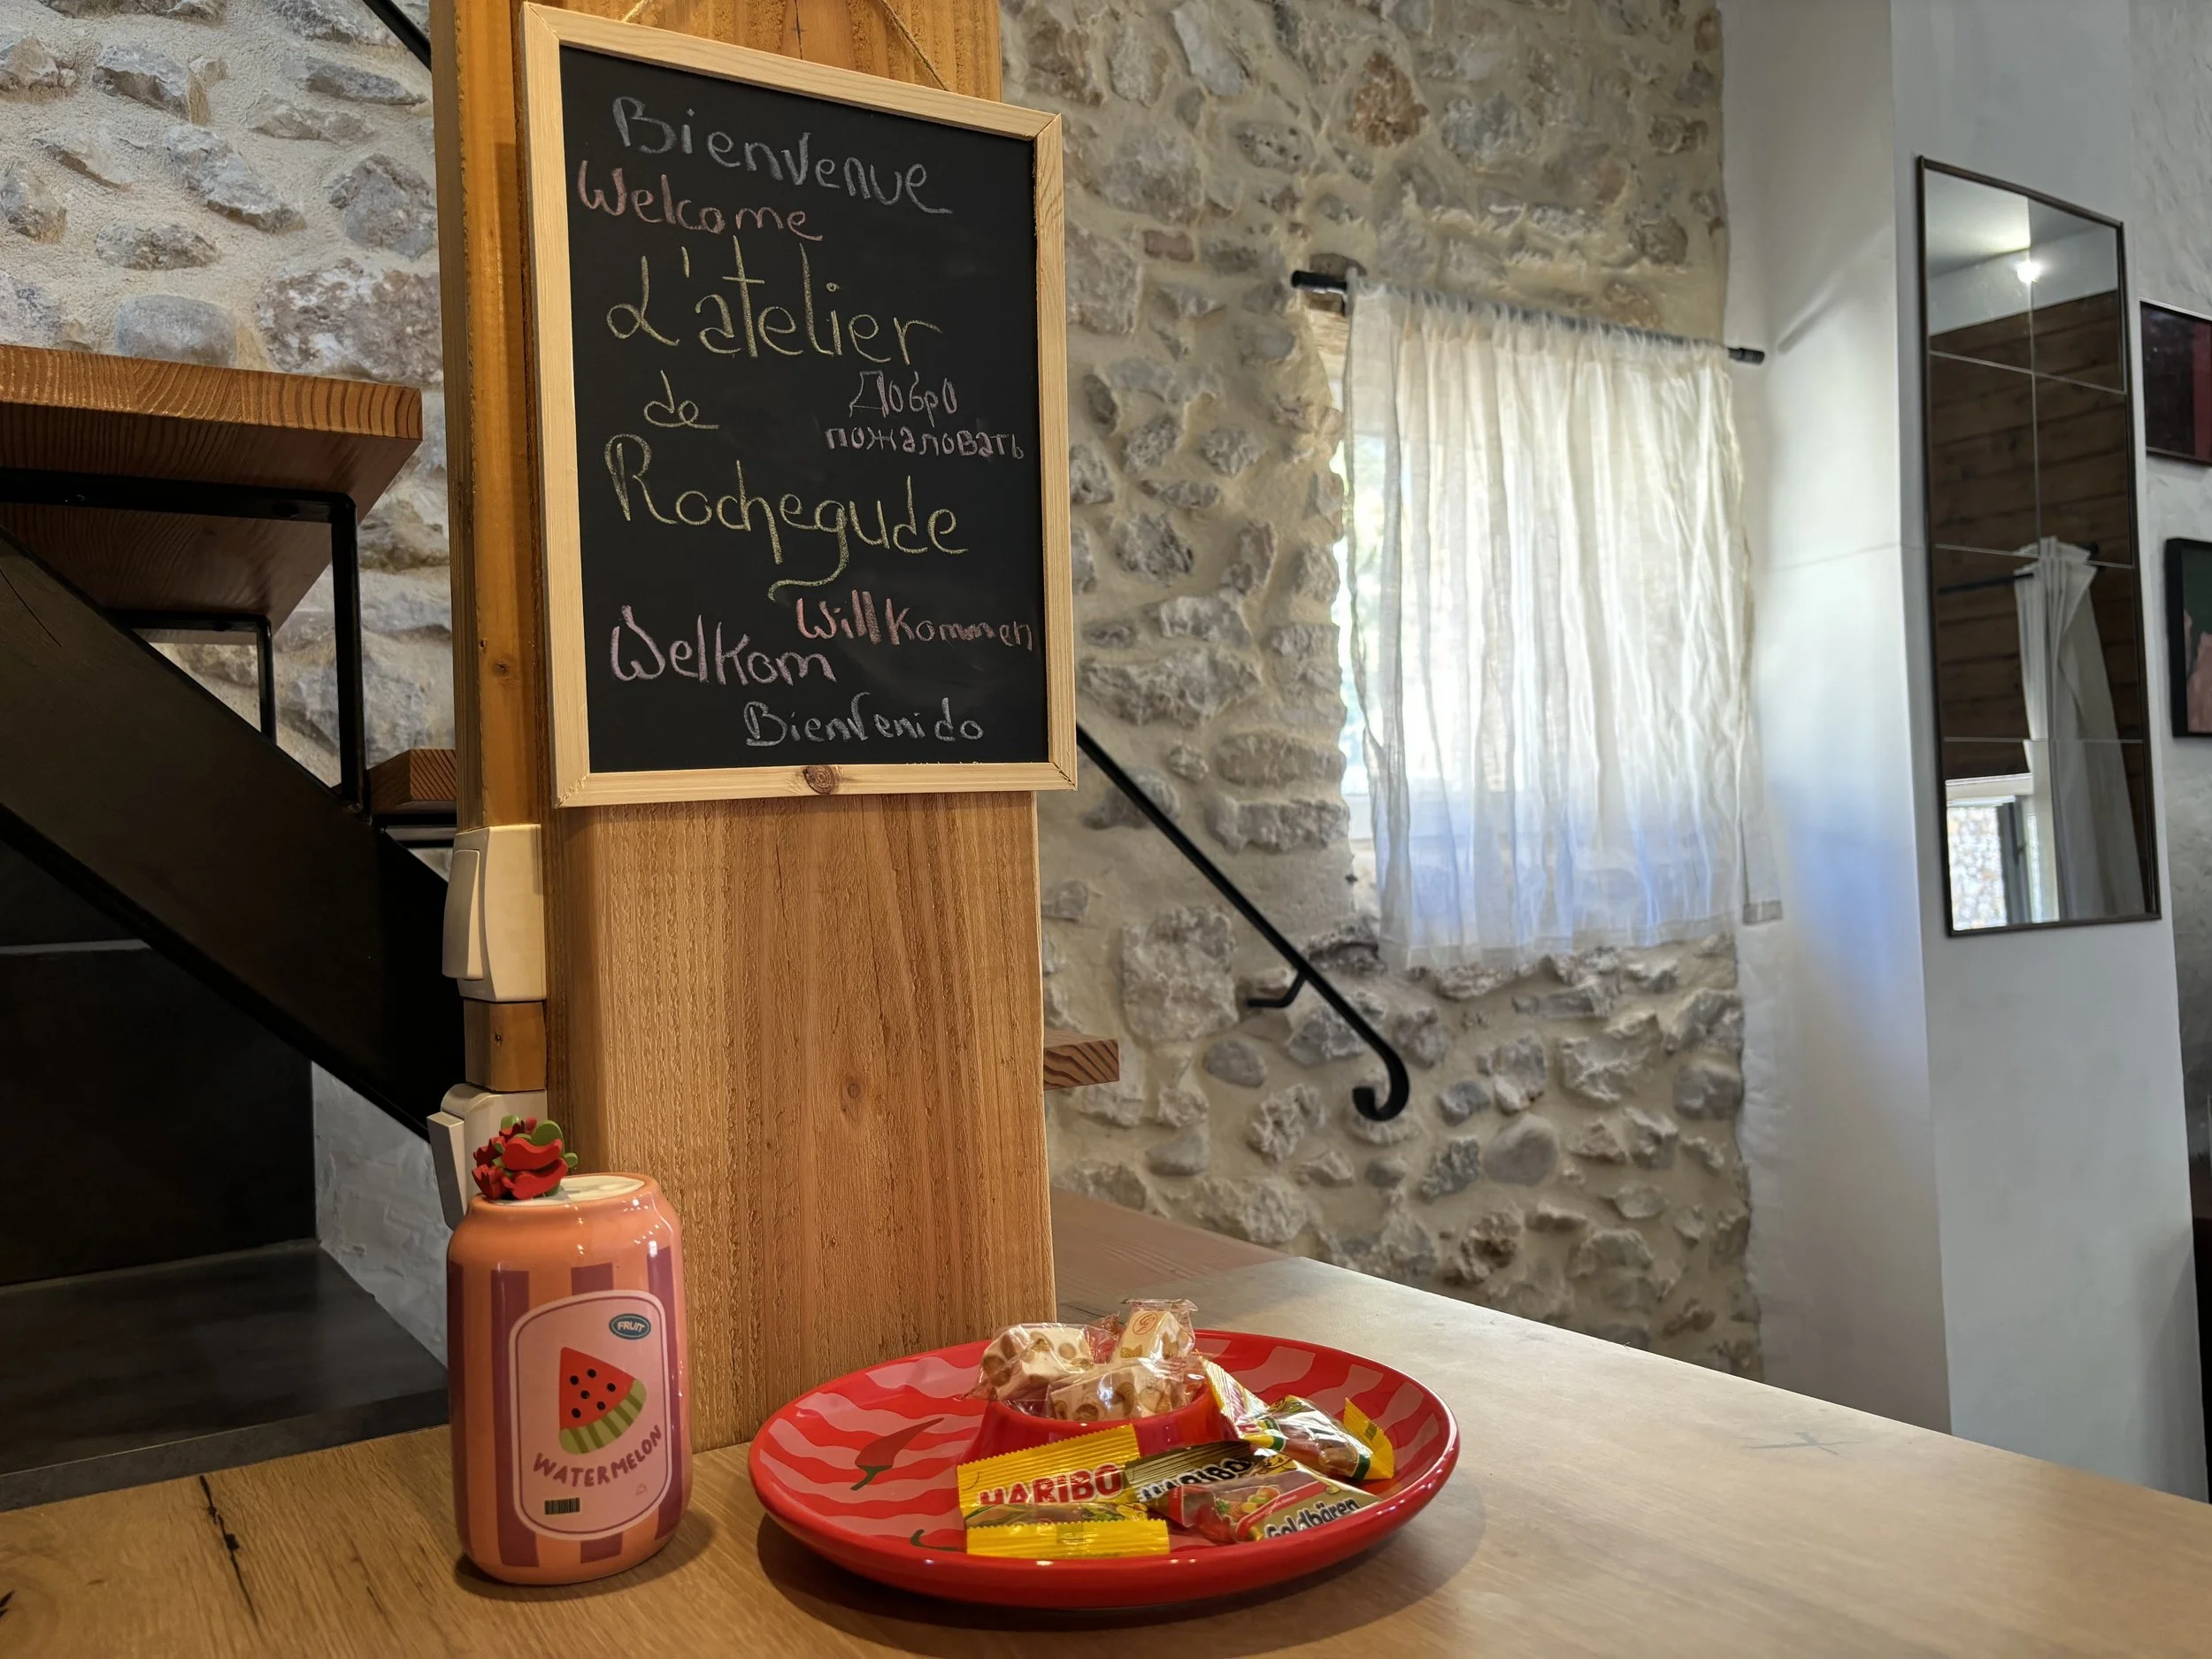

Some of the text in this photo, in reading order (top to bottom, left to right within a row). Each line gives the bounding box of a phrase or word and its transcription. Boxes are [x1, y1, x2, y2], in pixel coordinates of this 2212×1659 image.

[612, 96, 952, 214] Bienvenue
[578, 160, 823, 242] Welcome
[606, 235, 943, 365] L'atelier
[643, 370, 719, 429] de
[849, 370, 958, 428] Добро
[826, 426, 1025, 460] пожаловать
[604, 433, 969, 601] Rochegude
[617, 1320, 645, 1333] FRUIT
[533, 1424, 662, 1487] WATERMELON
